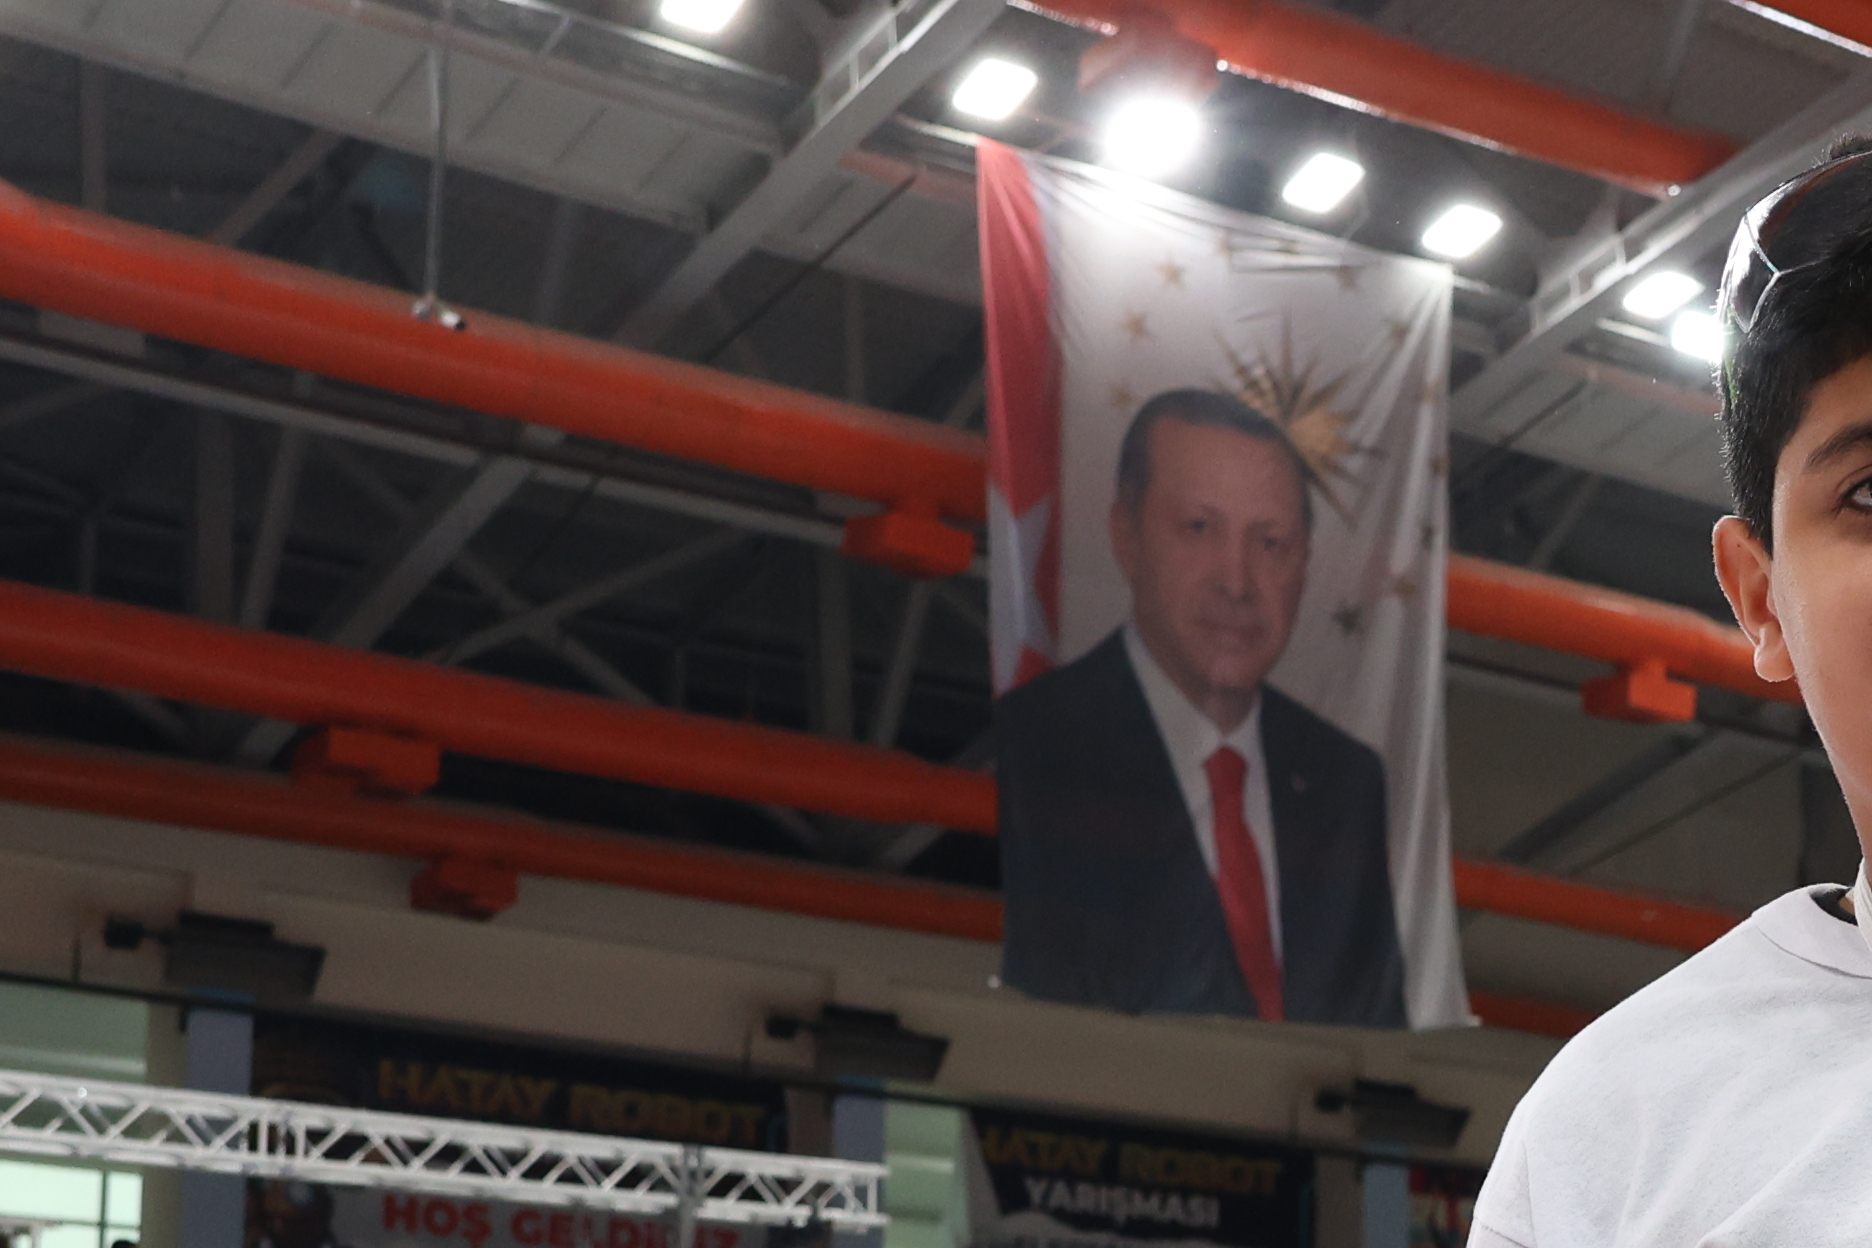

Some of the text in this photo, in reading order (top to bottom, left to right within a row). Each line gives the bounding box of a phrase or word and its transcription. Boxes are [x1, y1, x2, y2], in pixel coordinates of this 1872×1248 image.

[379, 1060, 768, 1147] HATAY ROBOT
[383, 1196, 491, 1248] HOŞ
